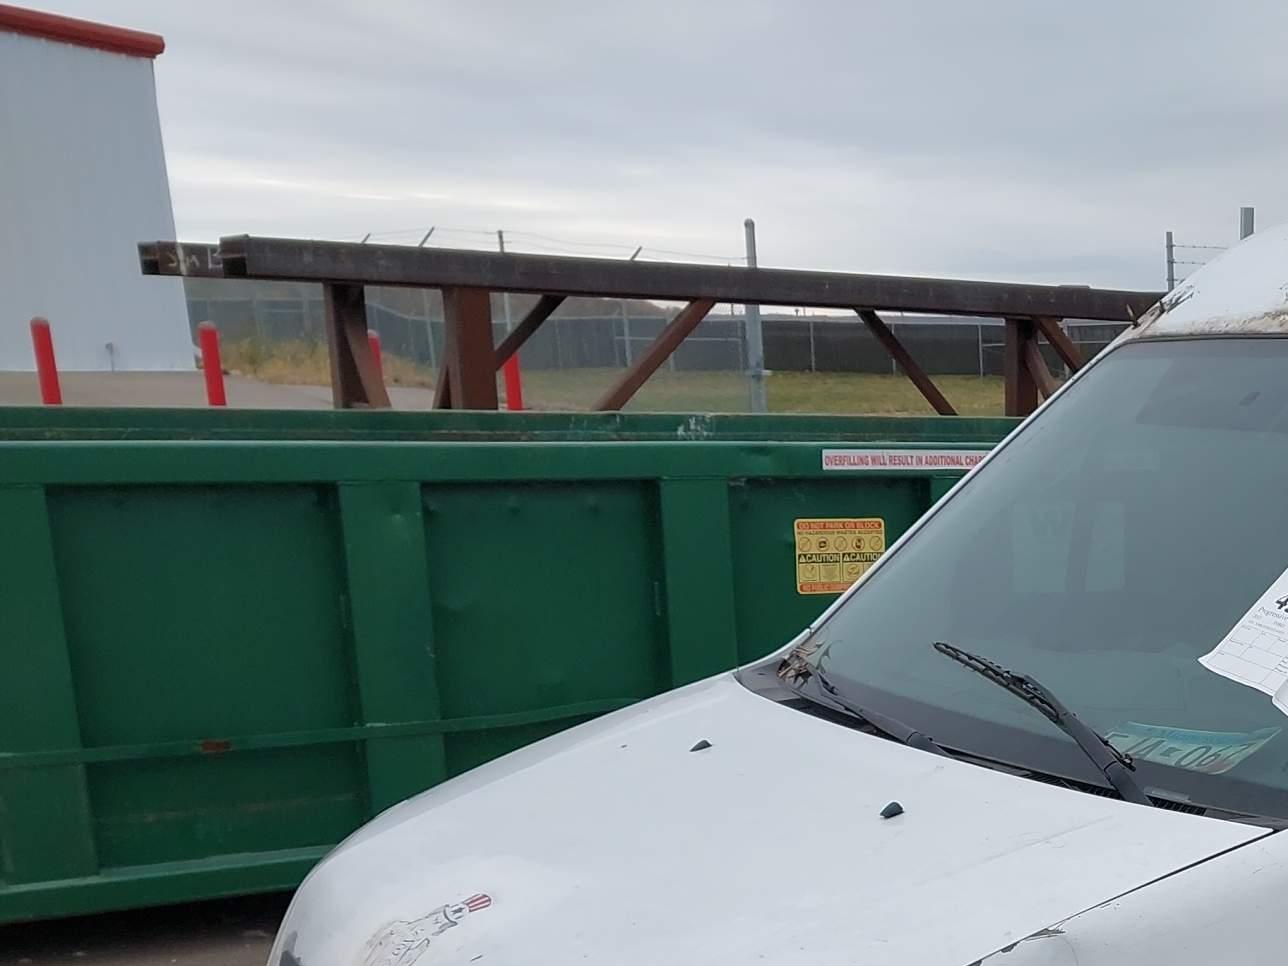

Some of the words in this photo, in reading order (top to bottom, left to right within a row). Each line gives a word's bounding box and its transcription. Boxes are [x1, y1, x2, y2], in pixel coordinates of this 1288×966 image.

[825, 455, 869, 466] OVERFILLING
[870, 455, 888, 465] WILL
[888, 455, 914, 465] RESULT
[915, 455, 924, 465] IN
[924, 455, 964, 465] ADDITIONAL
[965, 455, 986, 466] CHAR
[799, 522, 810, 530] DO
[845, 521, 856, 529] ON
[856, 521, 880, 529] BLOCK
[805, 554, 840, 562] CAUTION
